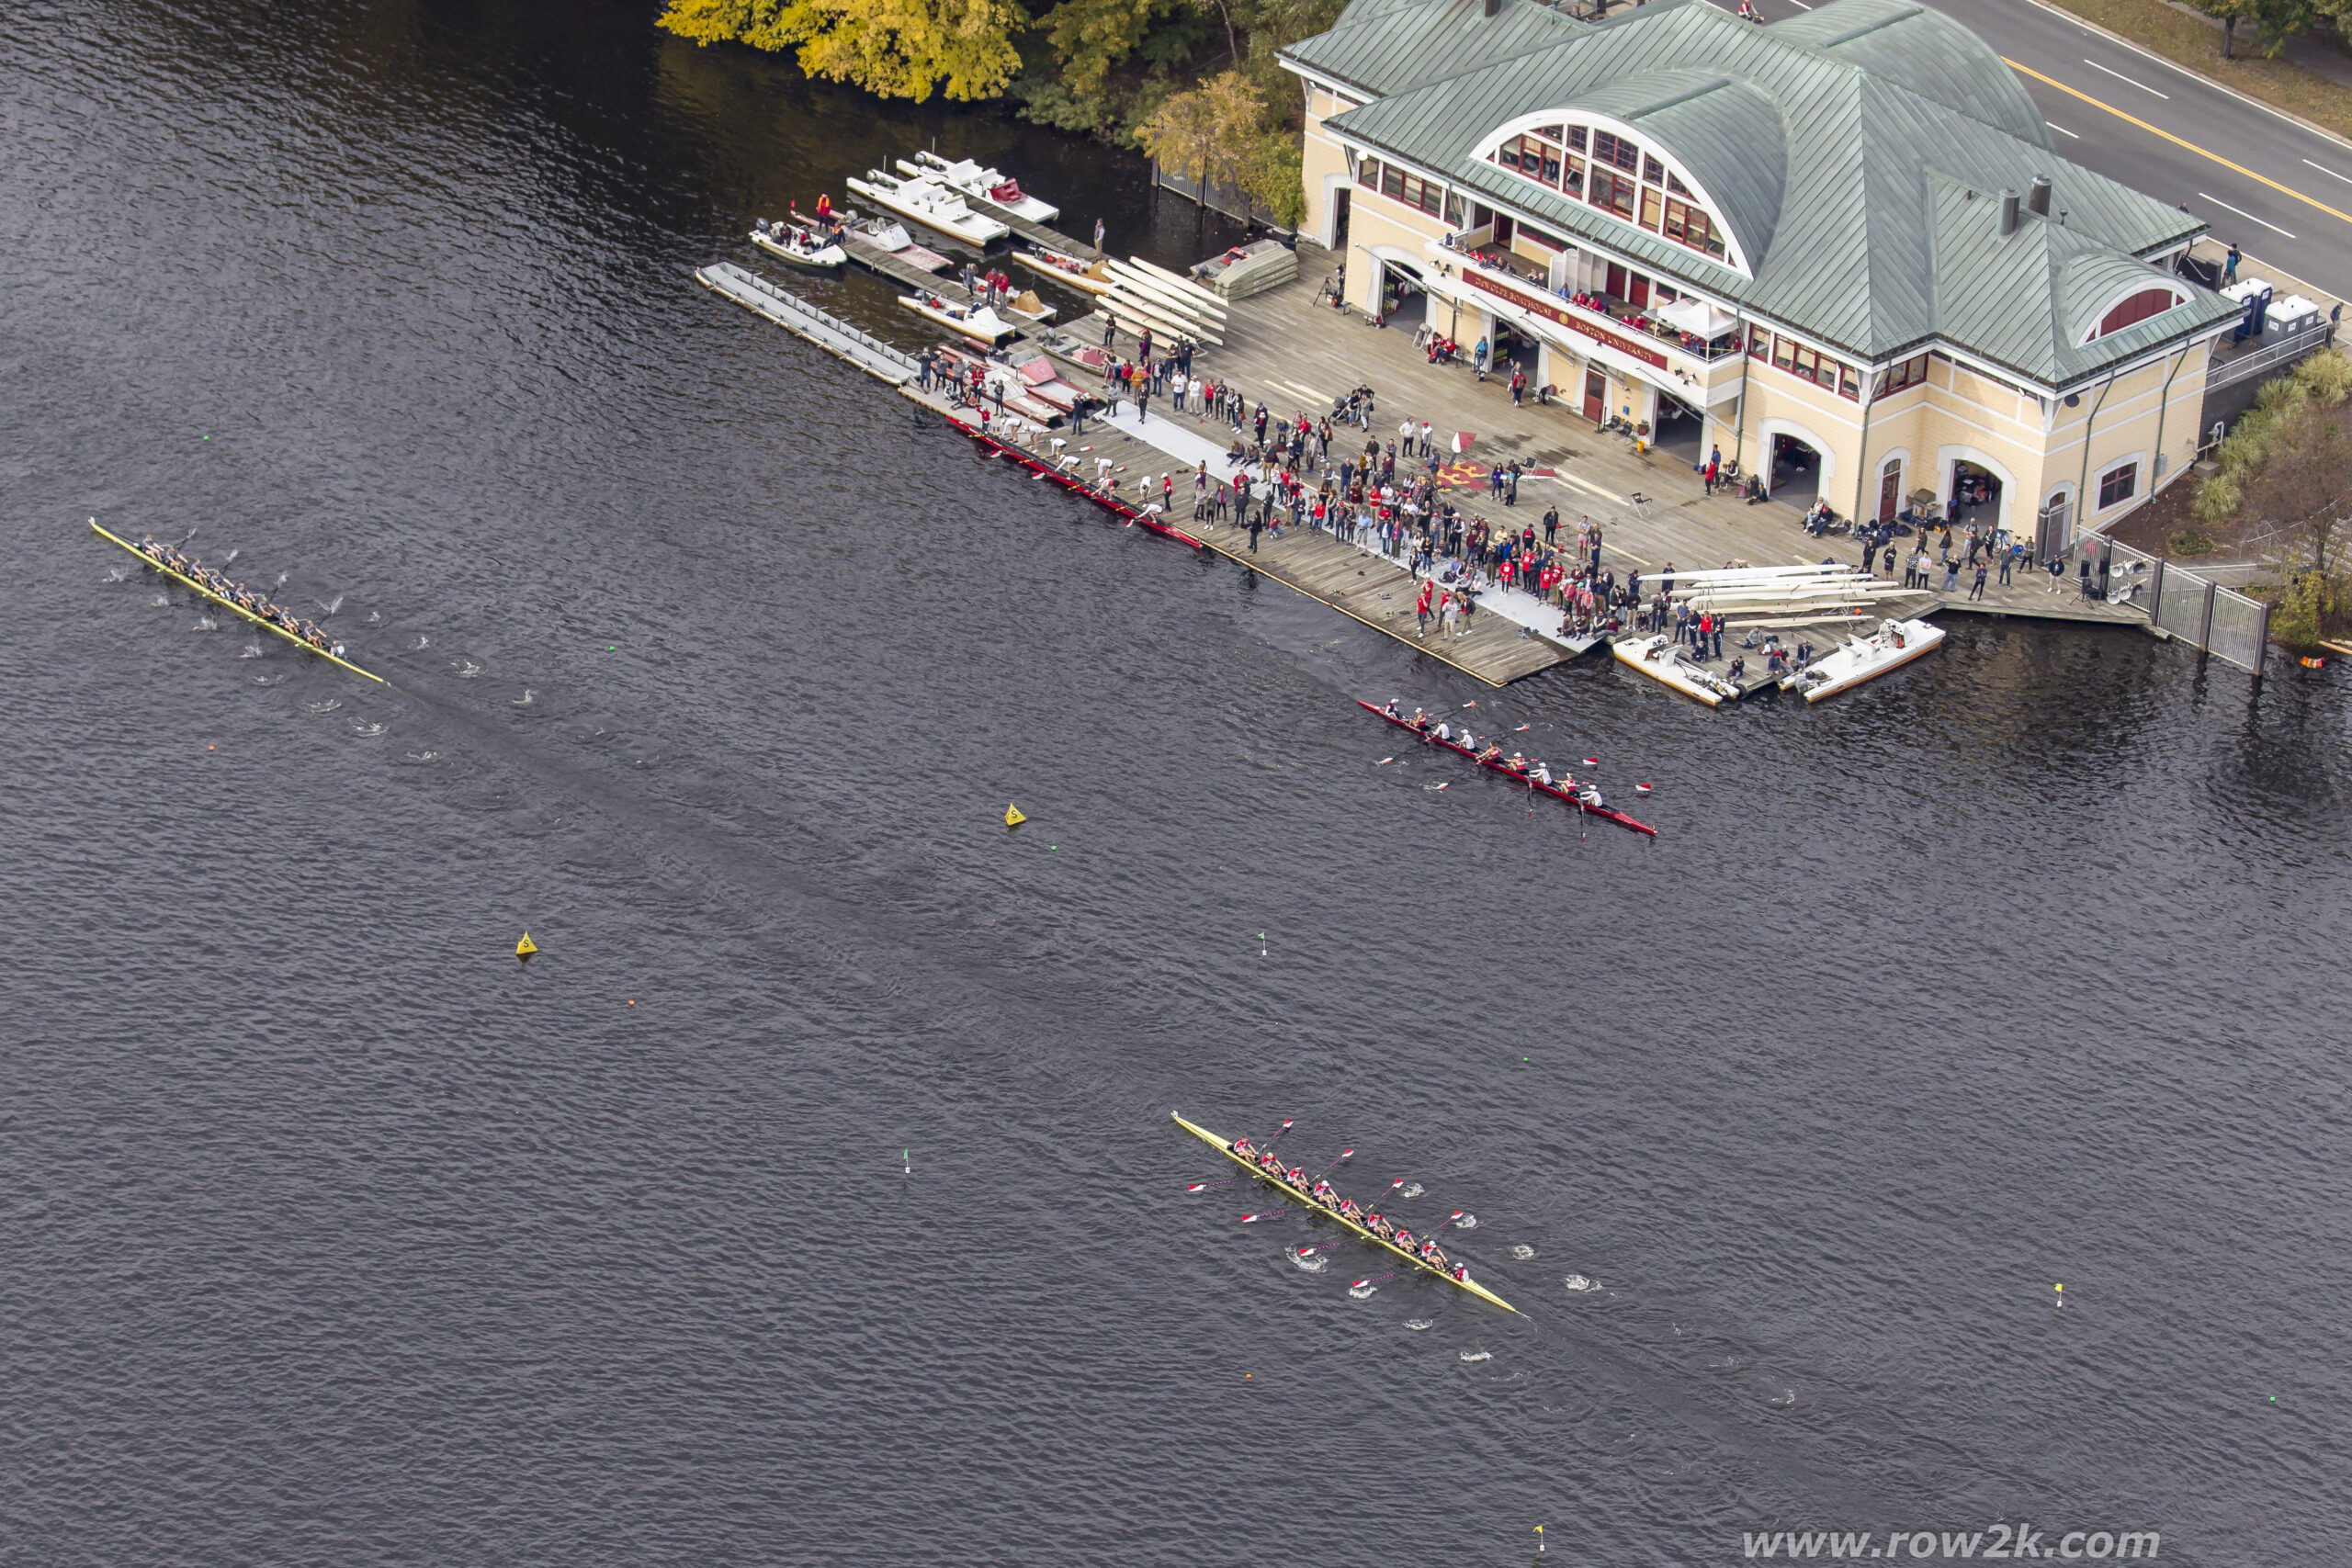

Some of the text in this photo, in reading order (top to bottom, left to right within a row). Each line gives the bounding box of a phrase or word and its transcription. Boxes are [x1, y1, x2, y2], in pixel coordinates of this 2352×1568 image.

[1510, 292, 1552, 316] BOATHOUSE
[1576, 321, 1654, 361] BOSTON UNIVERSITY
[1011, 810, 1018, 818] S
[523, 939, 529, 948] S
